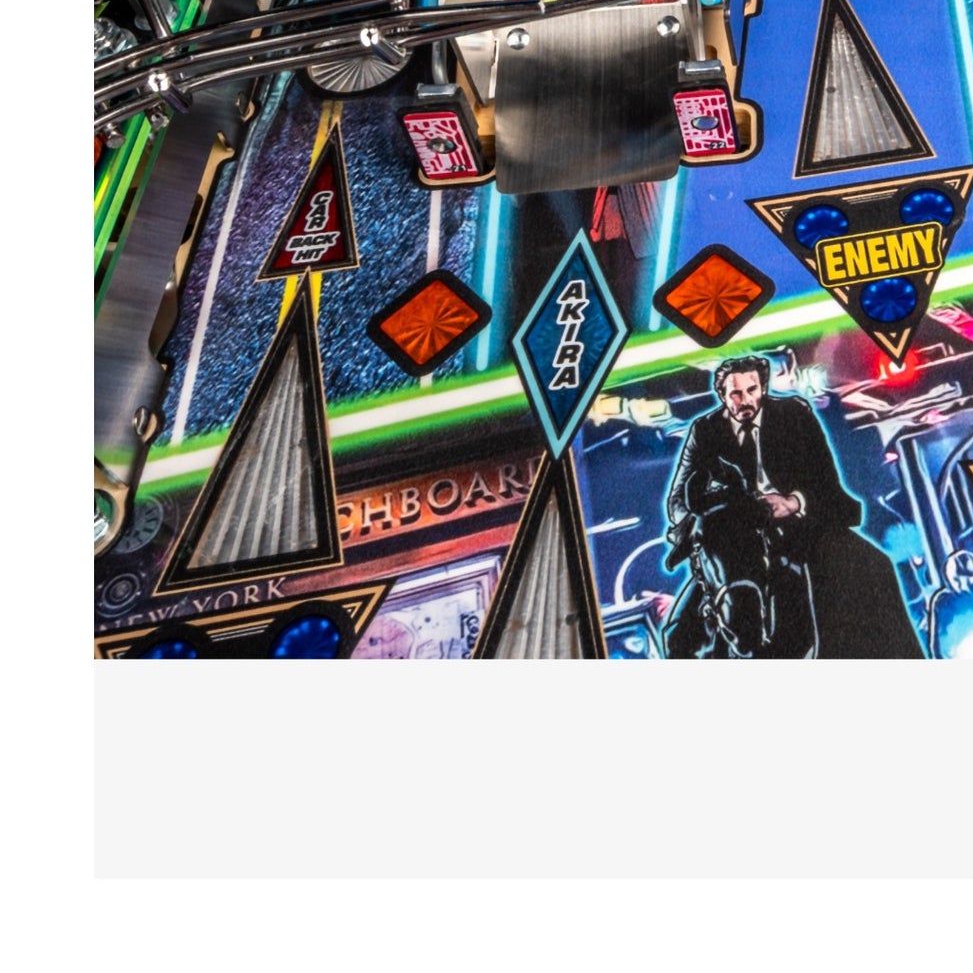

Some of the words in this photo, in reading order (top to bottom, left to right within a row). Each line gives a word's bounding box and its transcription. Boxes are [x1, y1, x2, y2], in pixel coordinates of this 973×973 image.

[306, 191, 333, 231] CAR
[287, 232, 340, 250] BACK
[293, 246, 328, 262] HIT
[824, 229, 937, 283] ENEMY
[550, 280, 588, 388] AKIRA
[192, 576, 287, 617] YORK
